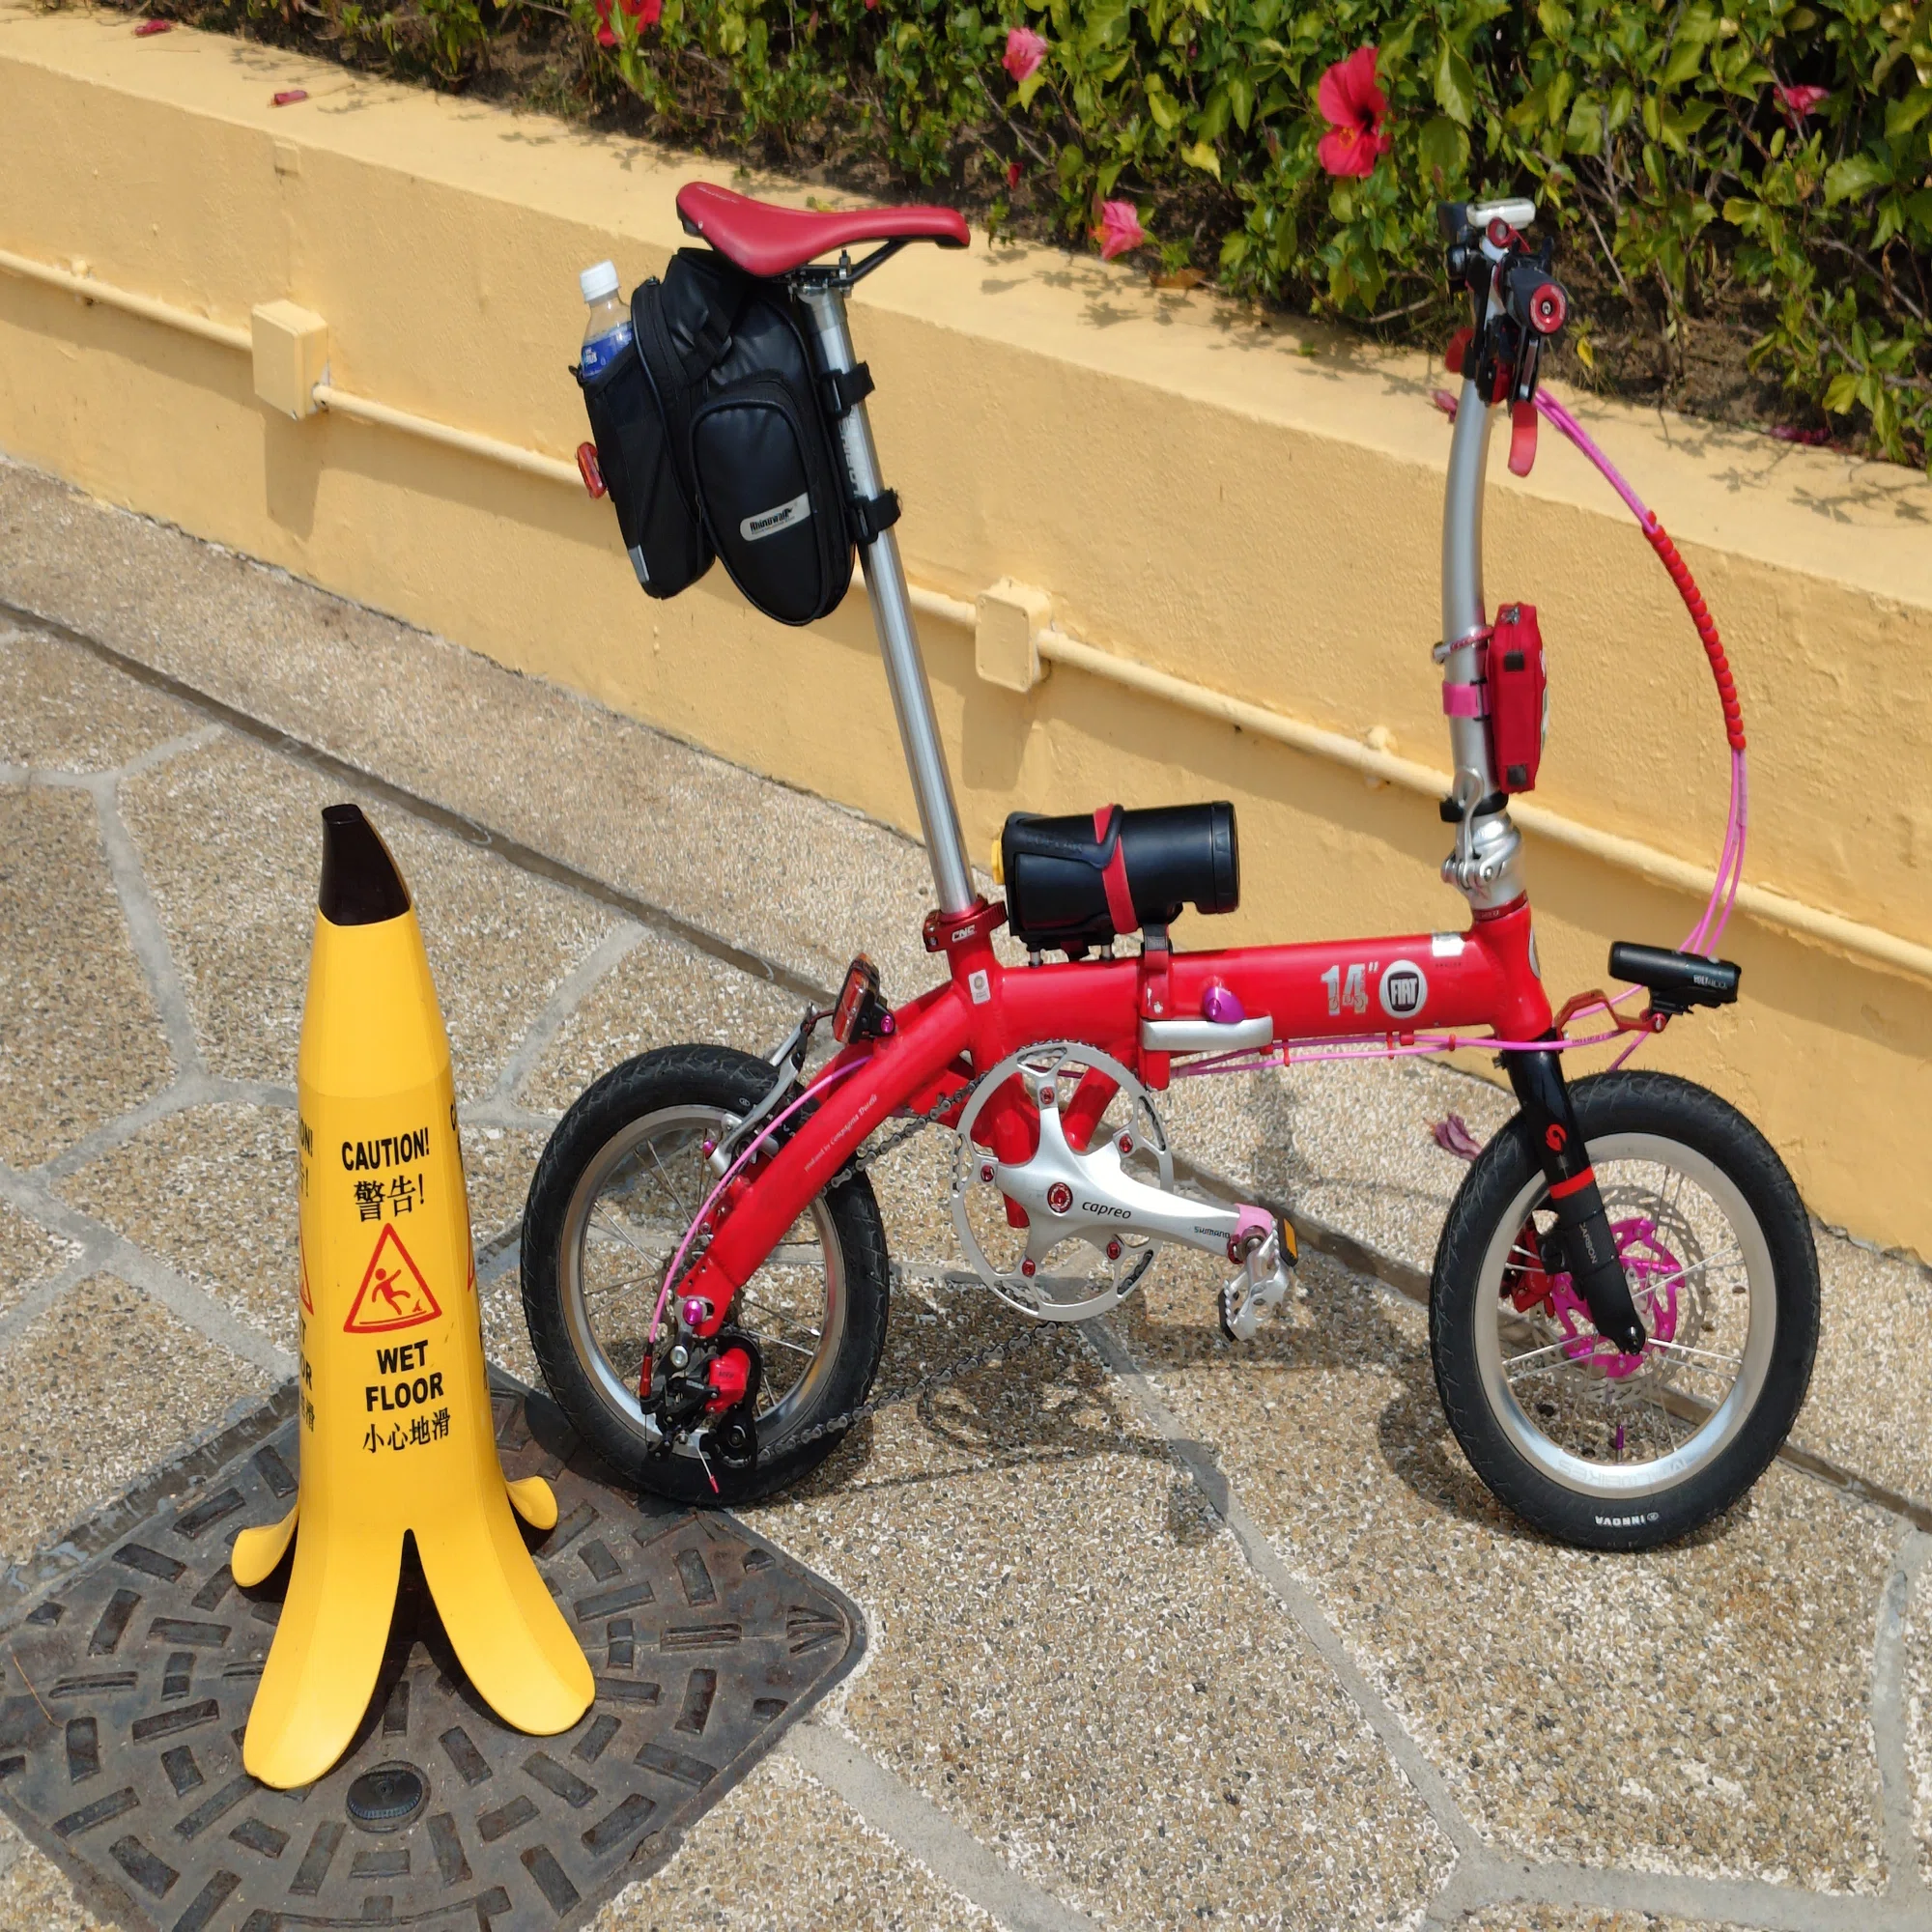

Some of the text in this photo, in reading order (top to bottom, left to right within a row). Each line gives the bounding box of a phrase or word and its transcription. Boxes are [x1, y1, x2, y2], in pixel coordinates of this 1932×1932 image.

[1390, 978, 1418, 1006] FIAT
[342, 1126, 430, 1171] CAUTION!
[354, 1173, 425, 1222] 警告!
[1082, 1200, 1131, 1220] capreo
[1578, 1221, 1599, 1264] CARBON
[376, 1340, 429, 1375] WET
[365, 1372, 444, 1412] FLOOR
[362, 1406, 451, 1454] 小心地滑
[1595, 1514, 1644, 1527] INNOVA
